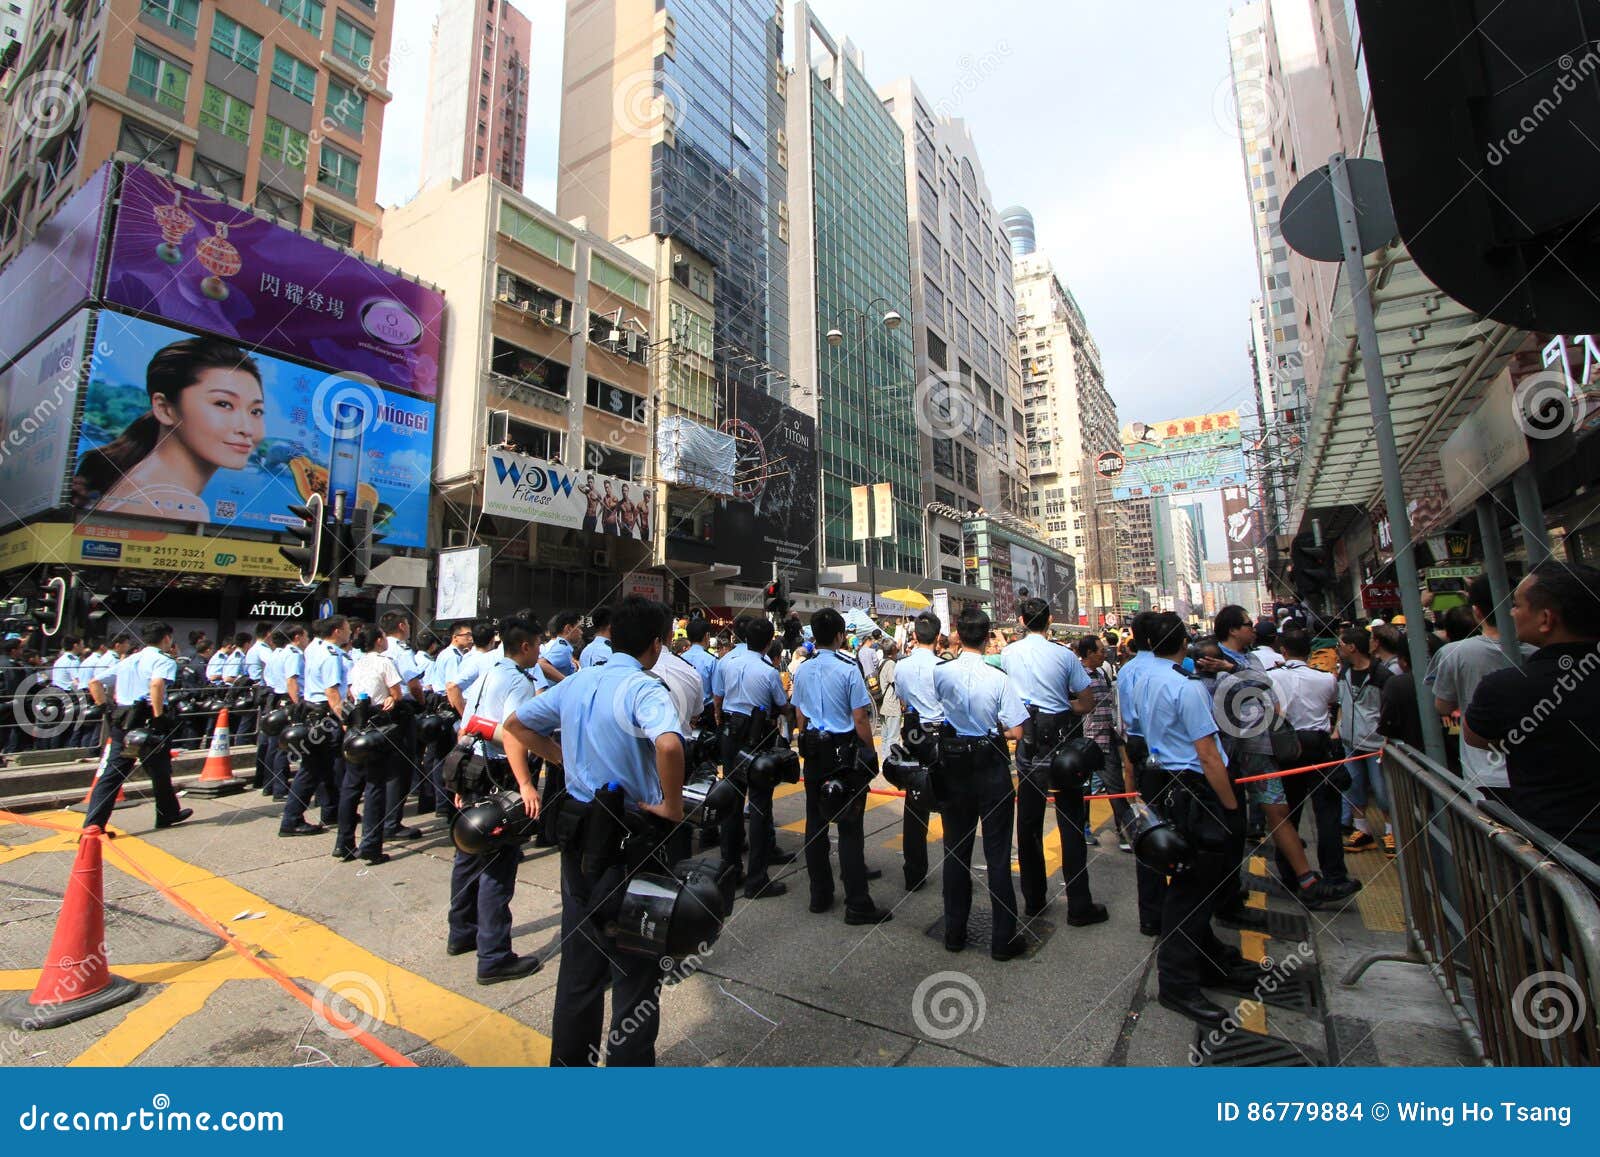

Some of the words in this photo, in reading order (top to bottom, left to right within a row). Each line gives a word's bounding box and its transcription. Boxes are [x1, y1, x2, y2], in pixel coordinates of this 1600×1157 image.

[259, 272, 345, 320] 閃耀登場
[783, 425, 809, 448] TITONI
[512, 483, 553, 506] Fitness
[154, 546, 178, 555] 2117
[181, 548, 206, 558] 3321
[152, 557, 178, 567] 2822
[180, 559, 206, 569] 0772
[1430, 567, 1480, 579] ROLEX
